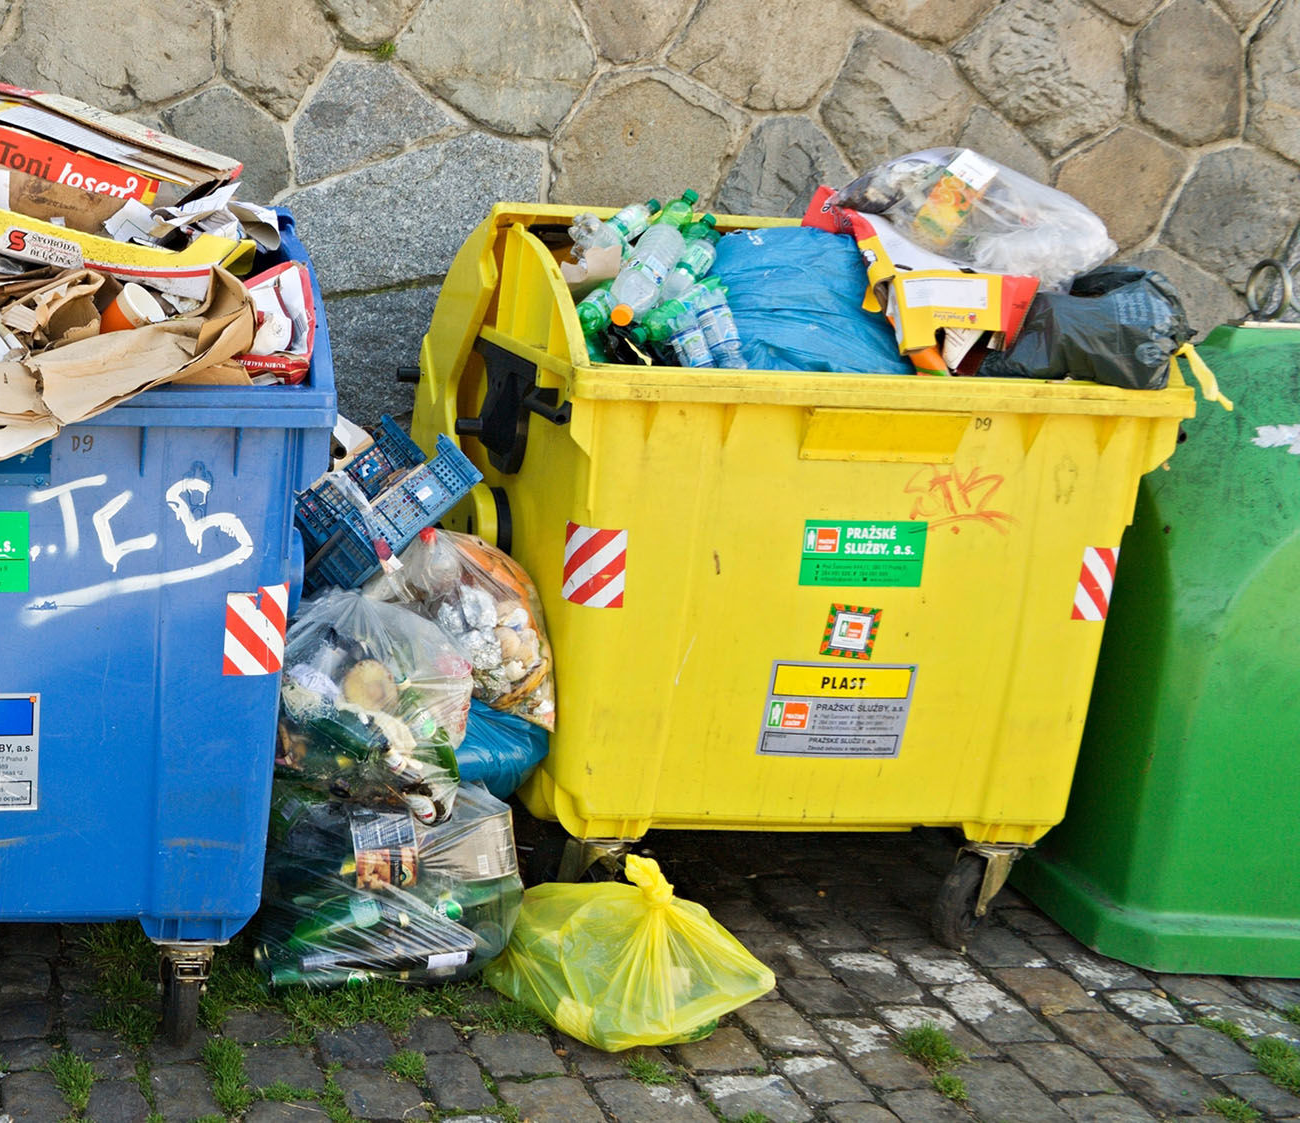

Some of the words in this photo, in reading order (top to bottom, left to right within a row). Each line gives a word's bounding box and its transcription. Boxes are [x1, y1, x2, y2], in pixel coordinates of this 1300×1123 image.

[71, 434, 94, 454] D9
[845, 524, 898, 540] PRAŽSKÉ
[844, 540, 890, 556] SLUŽBY,
[893, 545, 915, 555] a.s.
[821, 676, 866, 690] PLAST
[17, 744, 34, 753] a.s.
